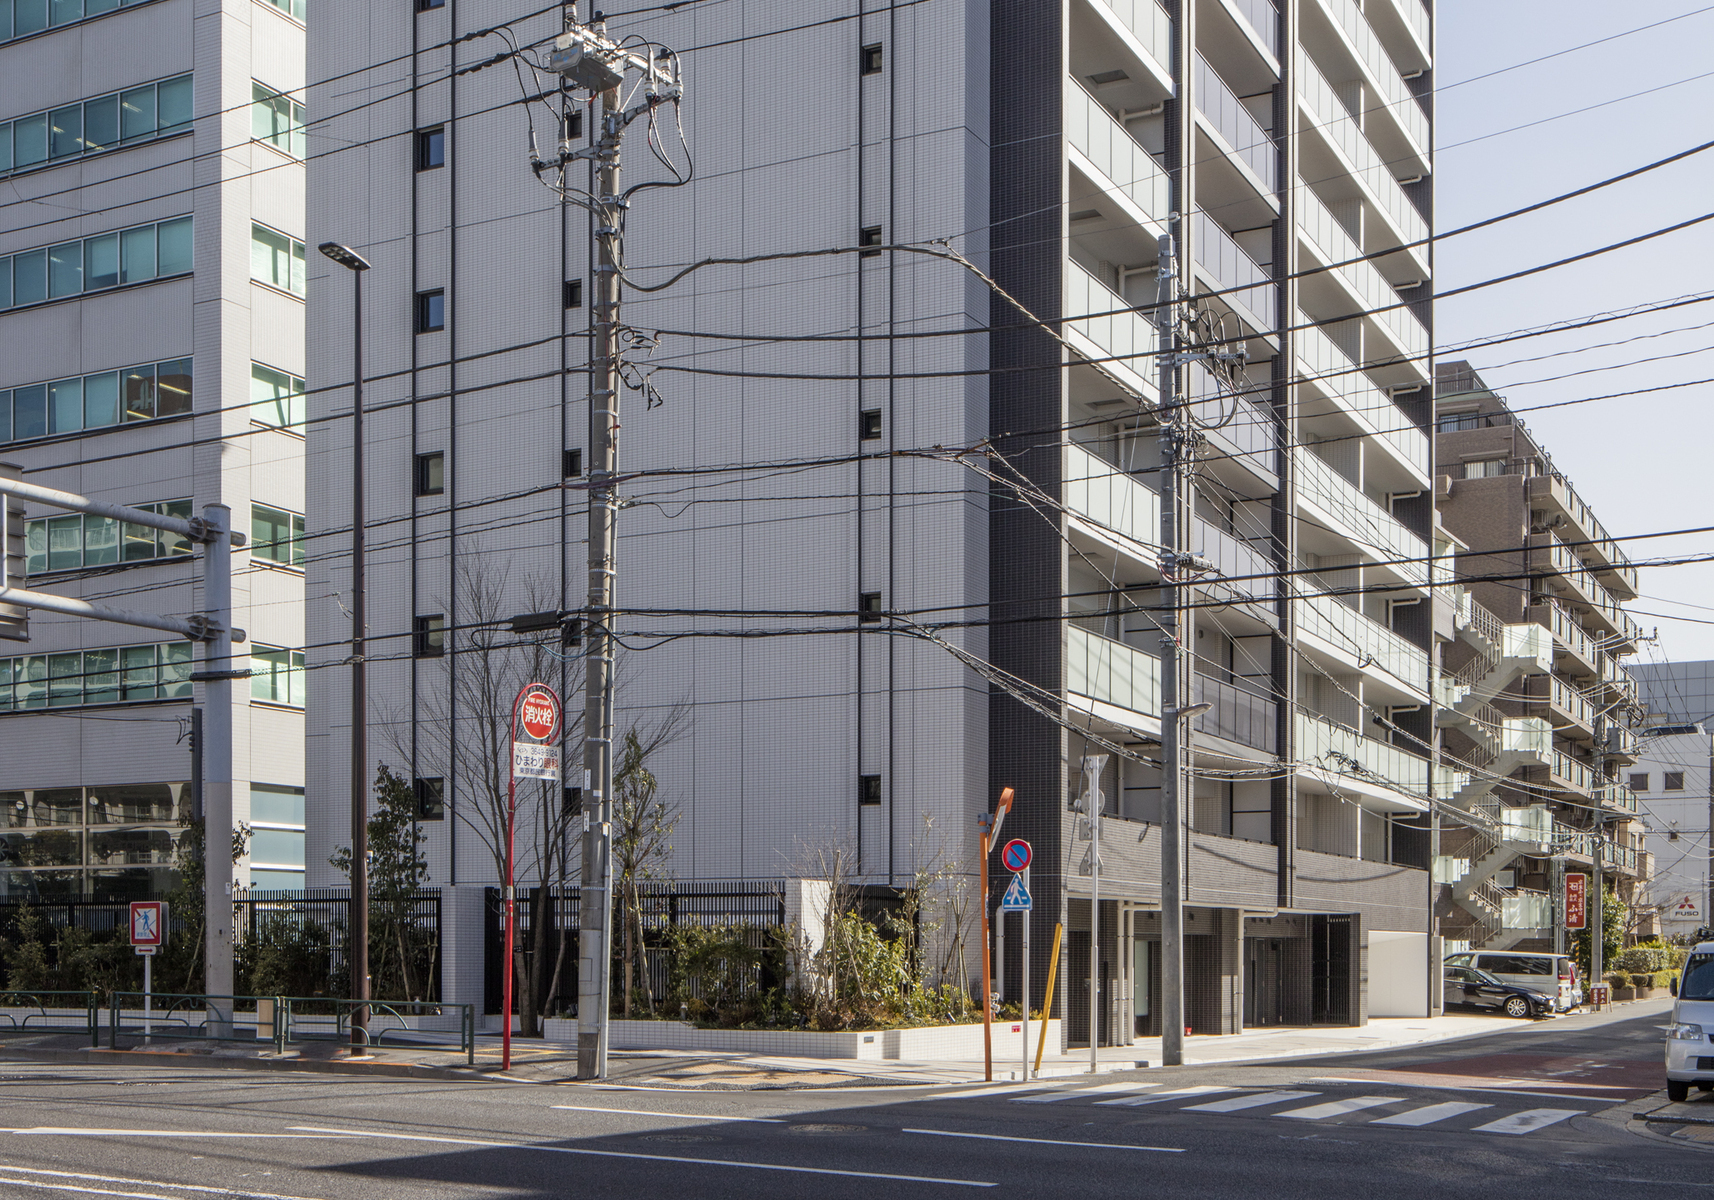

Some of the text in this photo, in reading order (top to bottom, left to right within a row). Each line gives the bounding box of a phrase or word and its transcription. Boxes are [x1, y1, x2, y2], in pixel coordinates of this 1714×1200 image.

[525, 705, 553, 726] 消火栓
[515, 754, 559, 770] ひまわり眼科
